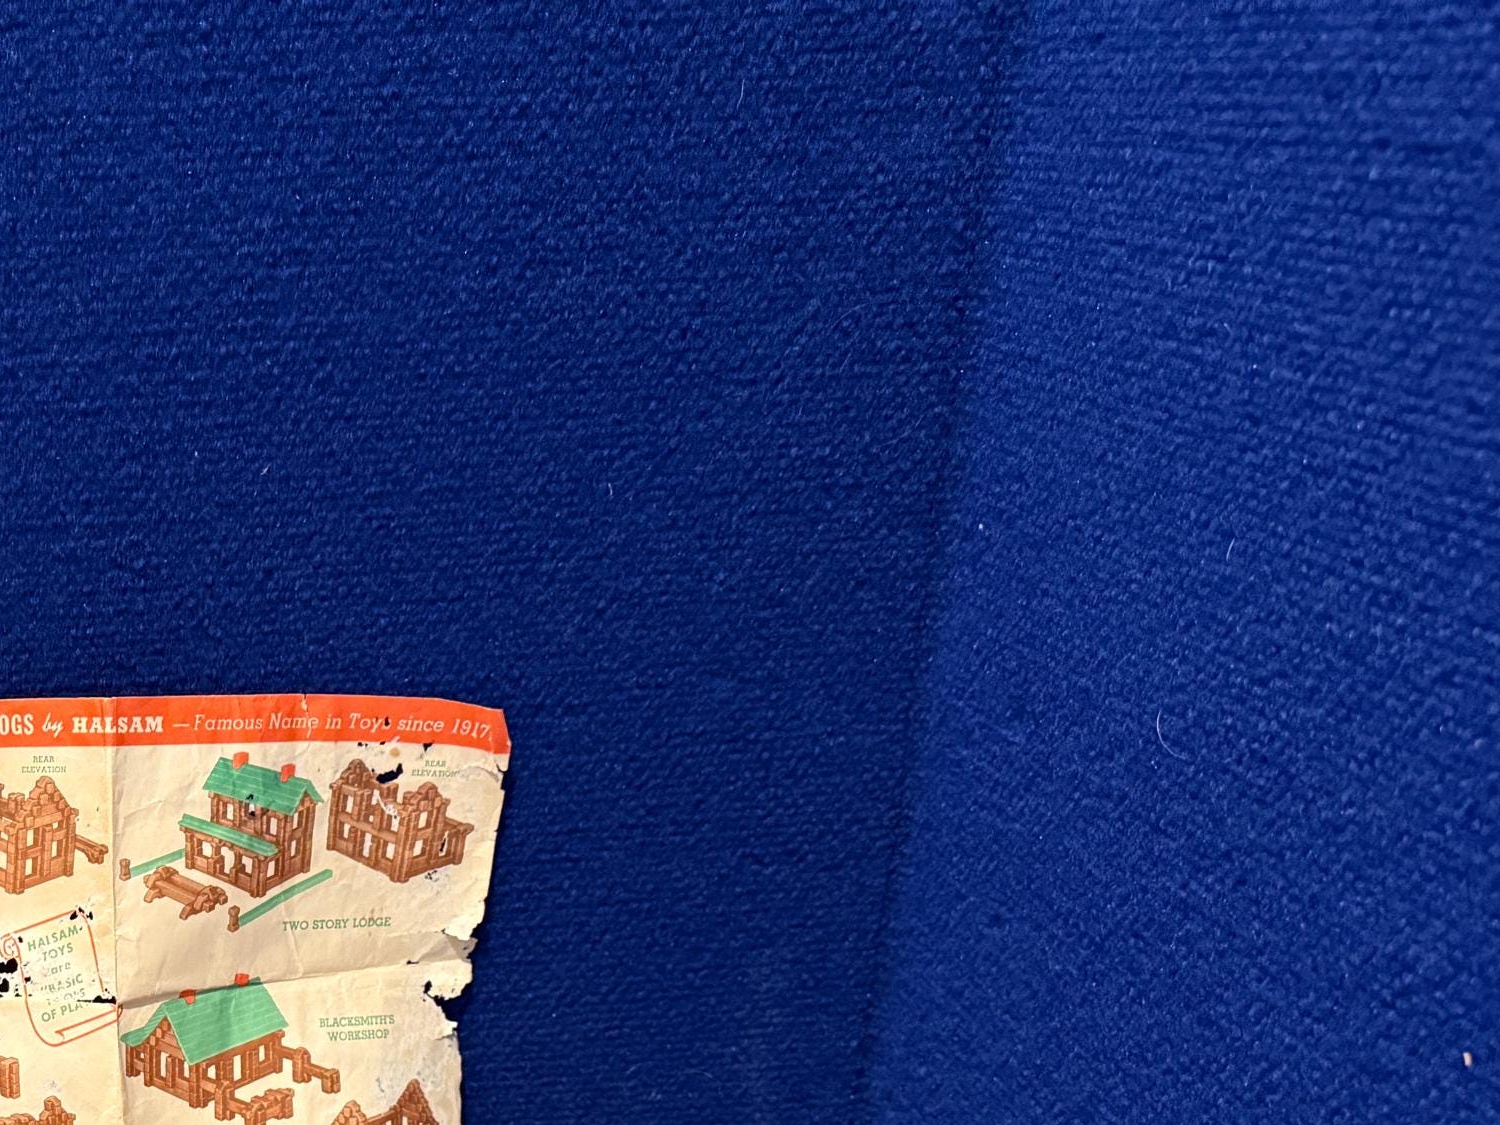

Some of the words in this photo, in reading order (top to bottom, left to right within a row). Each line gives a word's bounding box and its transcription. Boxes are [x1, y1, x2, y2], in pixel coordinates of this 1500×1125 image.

[42, 711, 64, 738] by
[71, 715, 164, 735] HALSAM
[193, 713, 264, 732] Famous
[268, 711, 319, 731] Name
[324, 713, 342, 730] in
[396, 715, 445, 732] since
[32, 755, 55, 764] REAR
[424, 760, 447, 768] REAR
[21, 765, 67, 774] ELEVATION
[282, 920, 309, 931] TWO
[312, 918, 349, 930] STORY
[352, 916, 392, 928] LODGE
[41, 942, 74, 961] TOYS
[41, 1008, 57, 1022] OF
[60, 1002, 89, 1016] PLA
[319, 1014, 396, 1028] BLACKSMITH'S
[327, 1029, 390, 1041] WORKSHOP
